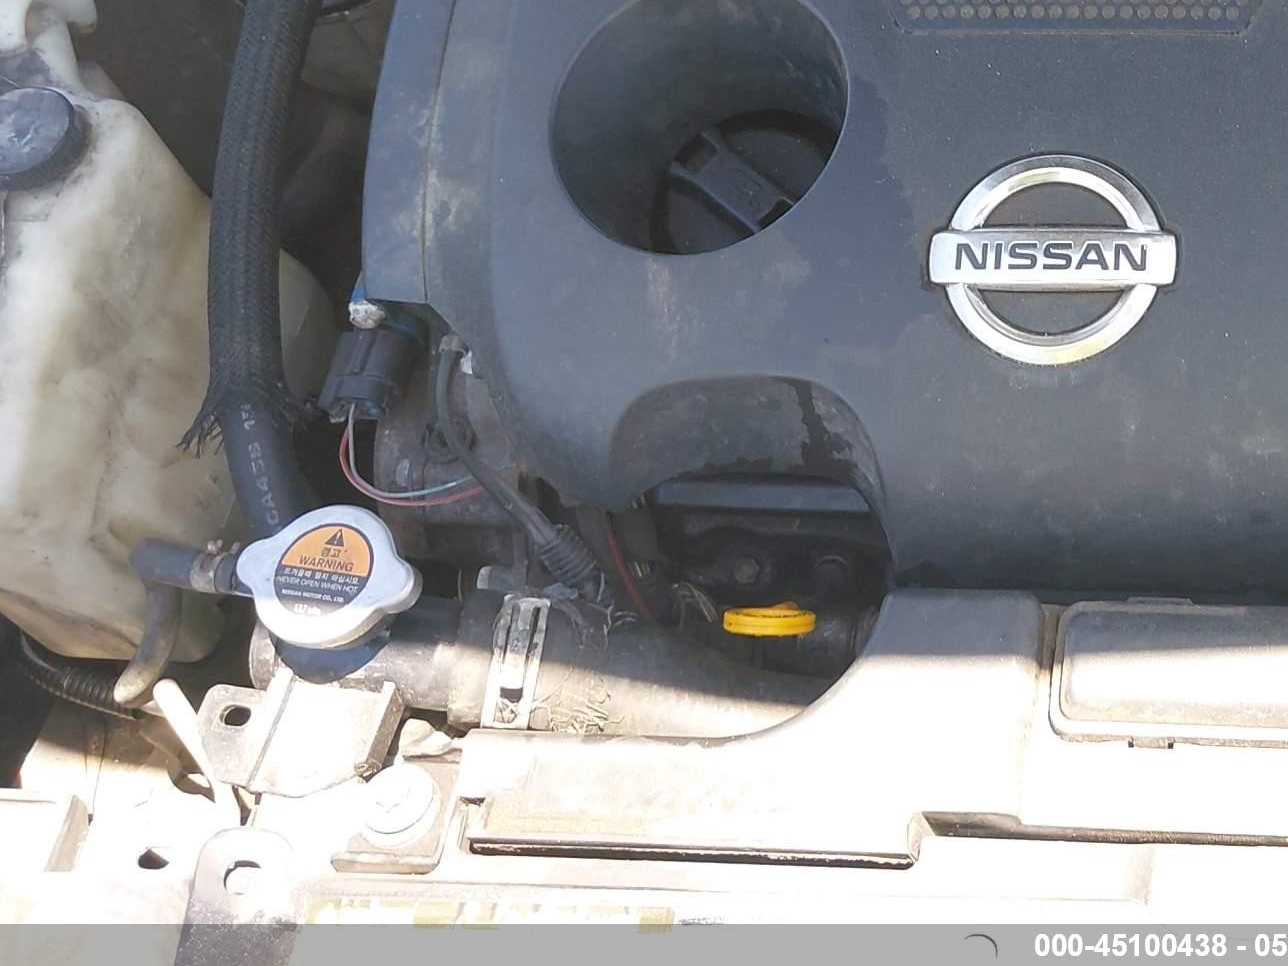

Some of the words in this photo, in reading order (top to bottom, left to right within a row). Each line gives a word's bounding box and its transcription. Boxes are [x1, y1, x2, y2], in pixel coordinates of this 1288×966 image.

[954, 241, 1148, 272] NISSAN
[299, 555, 354, 572] WARNING
[276, 575, 300, 585] NEVER
[300, 579, 321, 588] OPEN
[320, 582, 342, 591] WHEN
